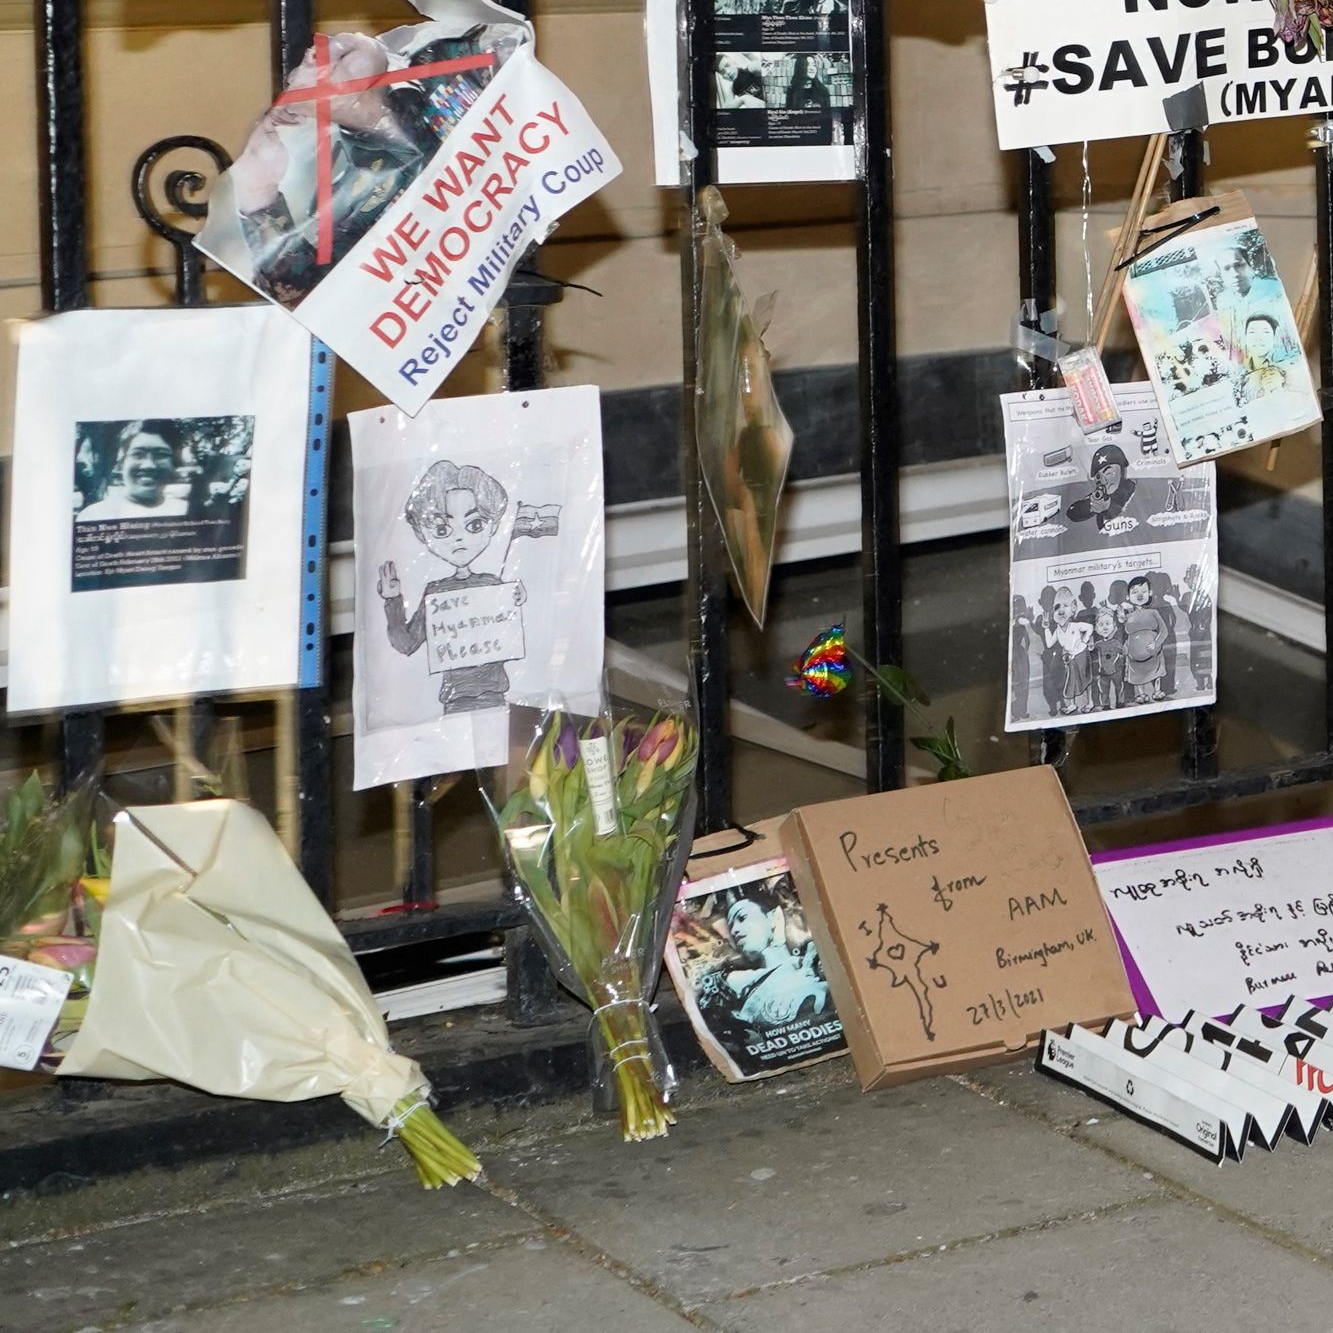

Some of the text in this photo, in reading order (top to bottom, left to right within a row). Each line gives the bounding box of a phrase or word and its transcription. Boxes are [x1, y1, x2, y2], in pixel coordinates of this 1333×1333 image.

[1002, 26, 1228, 108] #SAVE
[359, 93, 515, 284] WE WANT
[368, 100, 570, 350] DEMOCRACY
[398, 147, 605, 386] Reject Military Coup
[1135, 456, 1167, 467] Criminals
[1103, 518, 1134, 532] Guns
[1054, 565, 1087, 578] Myanmar
[1088, 560, 1123, 575] military's
[432, 610, 517, 639] Myanmar
[436, 639, 502, 663] Please
[839, 830, 940, 873] Presents
[931, 874, 987, 912] from
[1008, 887, 1068, 921] AAM
[966, 987, 1045, 1027] 27/3/2021
[745, 1036, 788, 1056] DEAD
[787, 1019, 844, 1045] BODIES
[764, 1019, 812, 1039] HOW MANY
